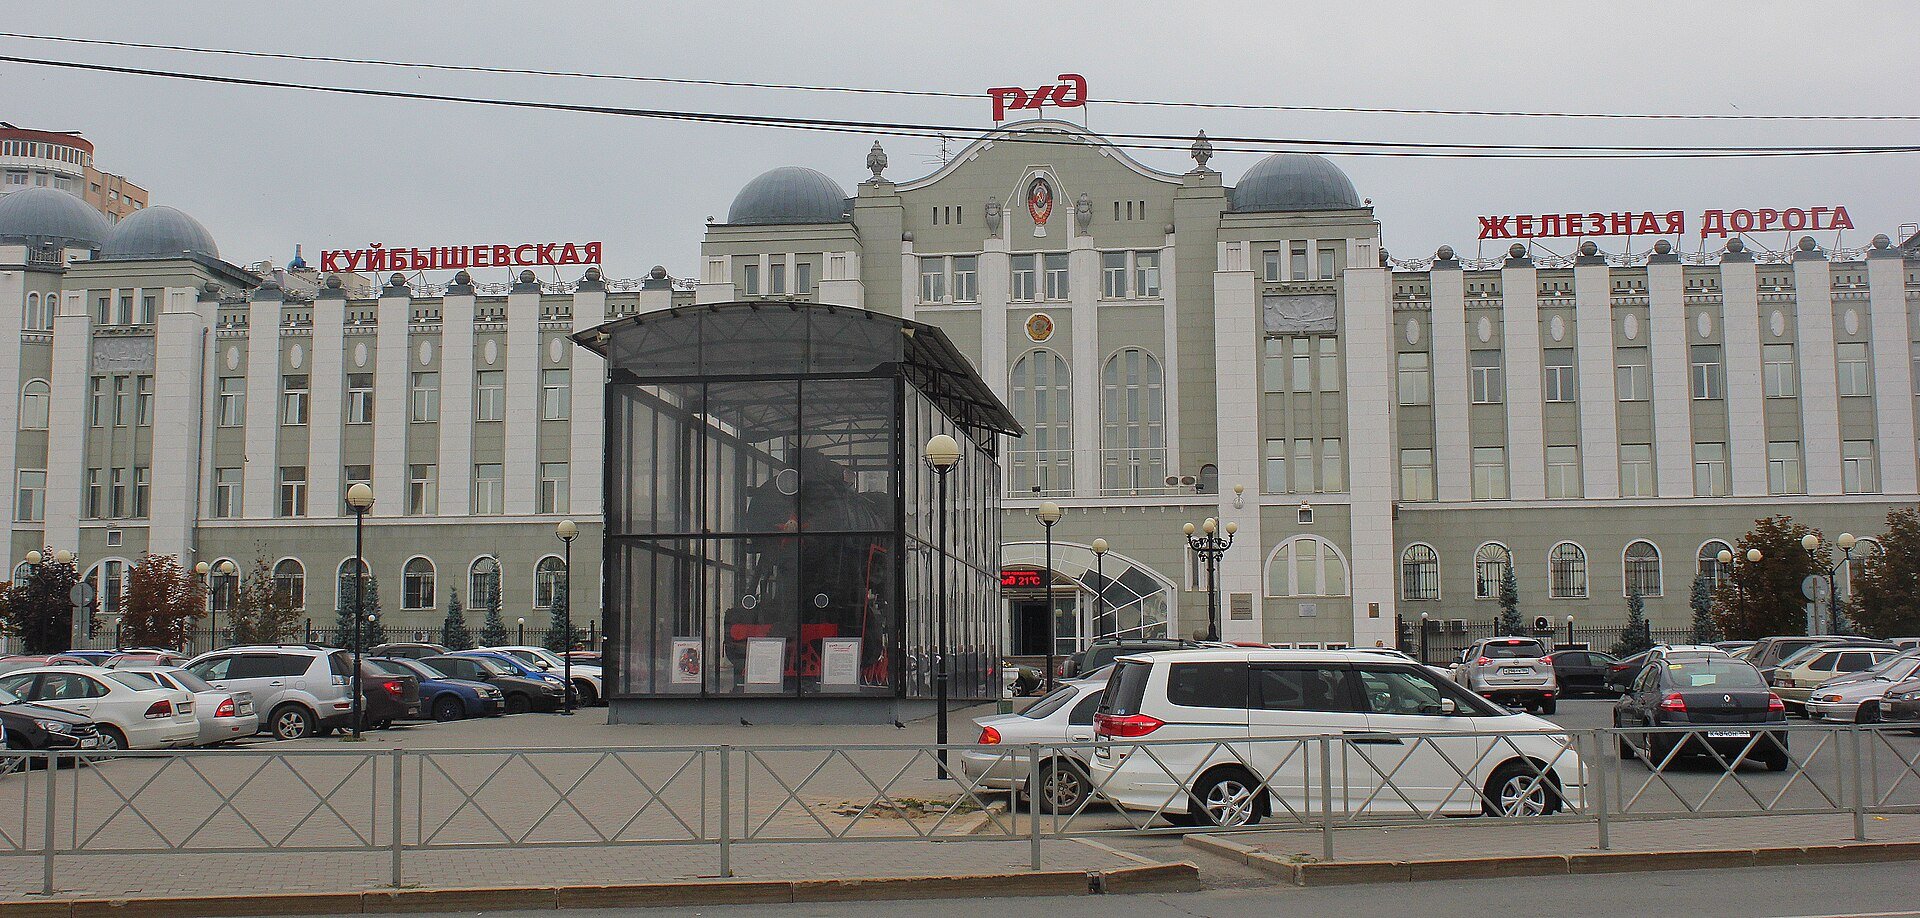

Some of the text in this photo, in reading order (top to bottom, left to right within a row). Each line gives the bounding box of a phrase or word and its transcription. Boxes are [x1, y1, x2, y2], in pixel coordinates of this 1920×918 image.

[1477, 206, 1855, 240] ЖЕЛЕЗНАЯ ДОРОГА
[320, 241, 602, 273] КУЙБЫШЕВСКАЯ
